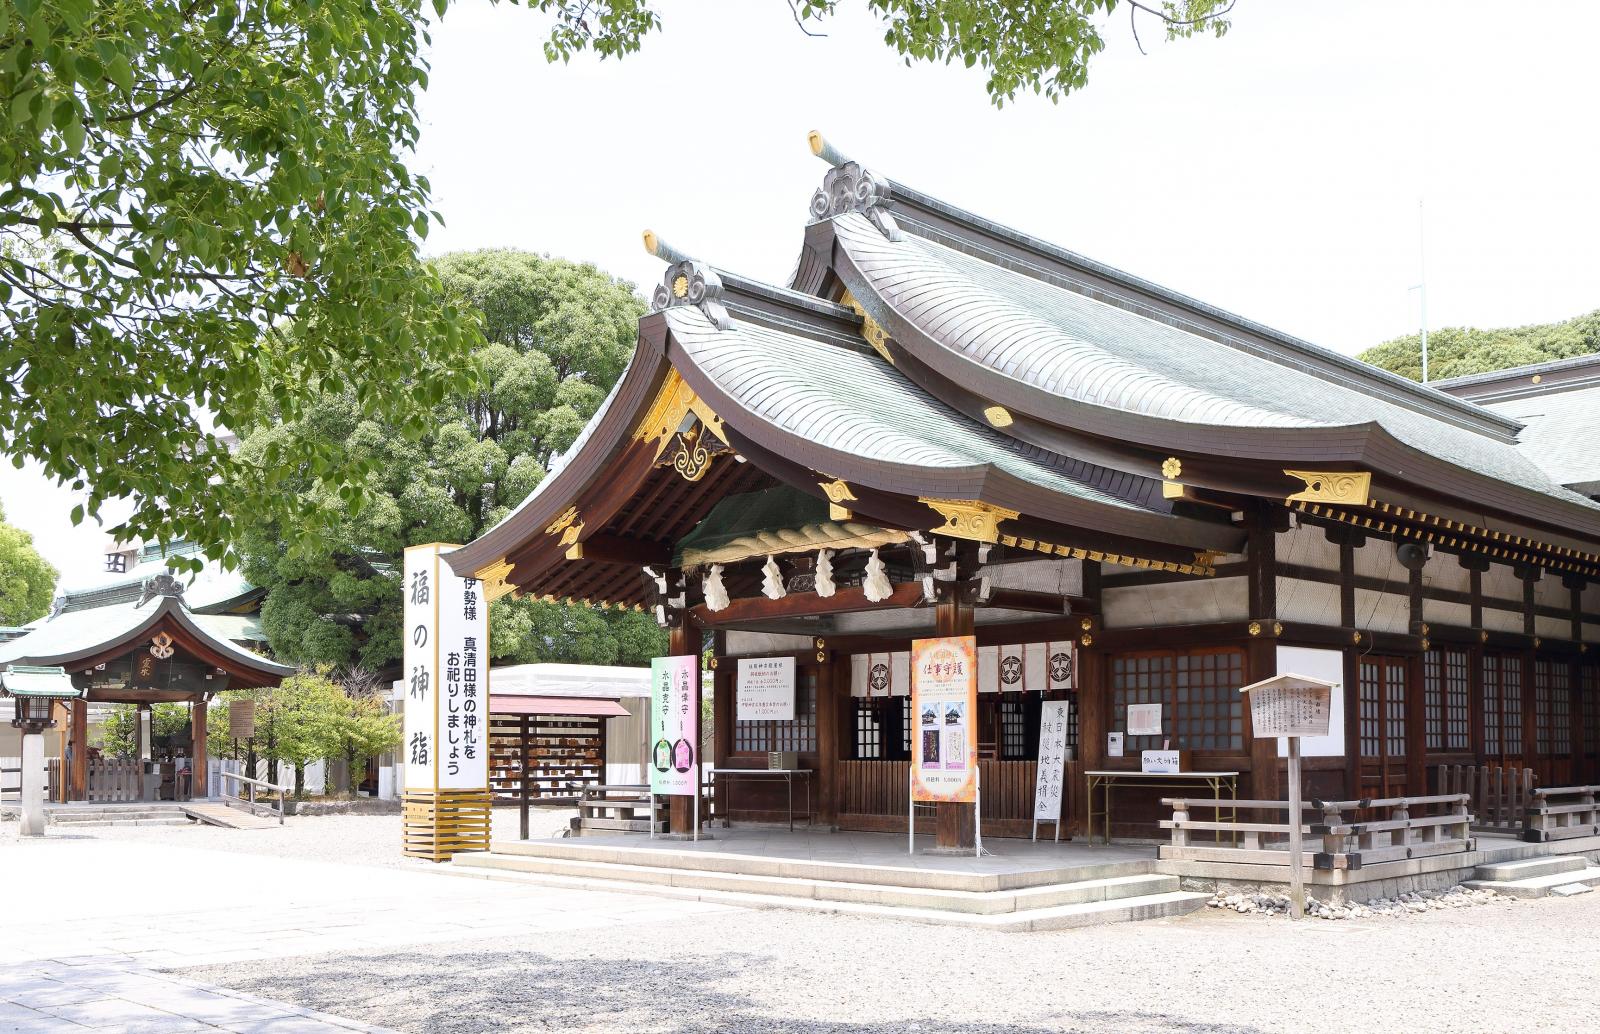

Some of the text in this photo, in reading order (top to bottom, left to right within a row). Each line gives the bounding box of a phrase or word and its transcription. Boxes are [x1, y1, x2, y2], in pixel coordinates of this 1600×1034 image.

[446, 651, 460, 776] お祀りしましょう
[463, 636, 477, 760] 真清田様の神札を
